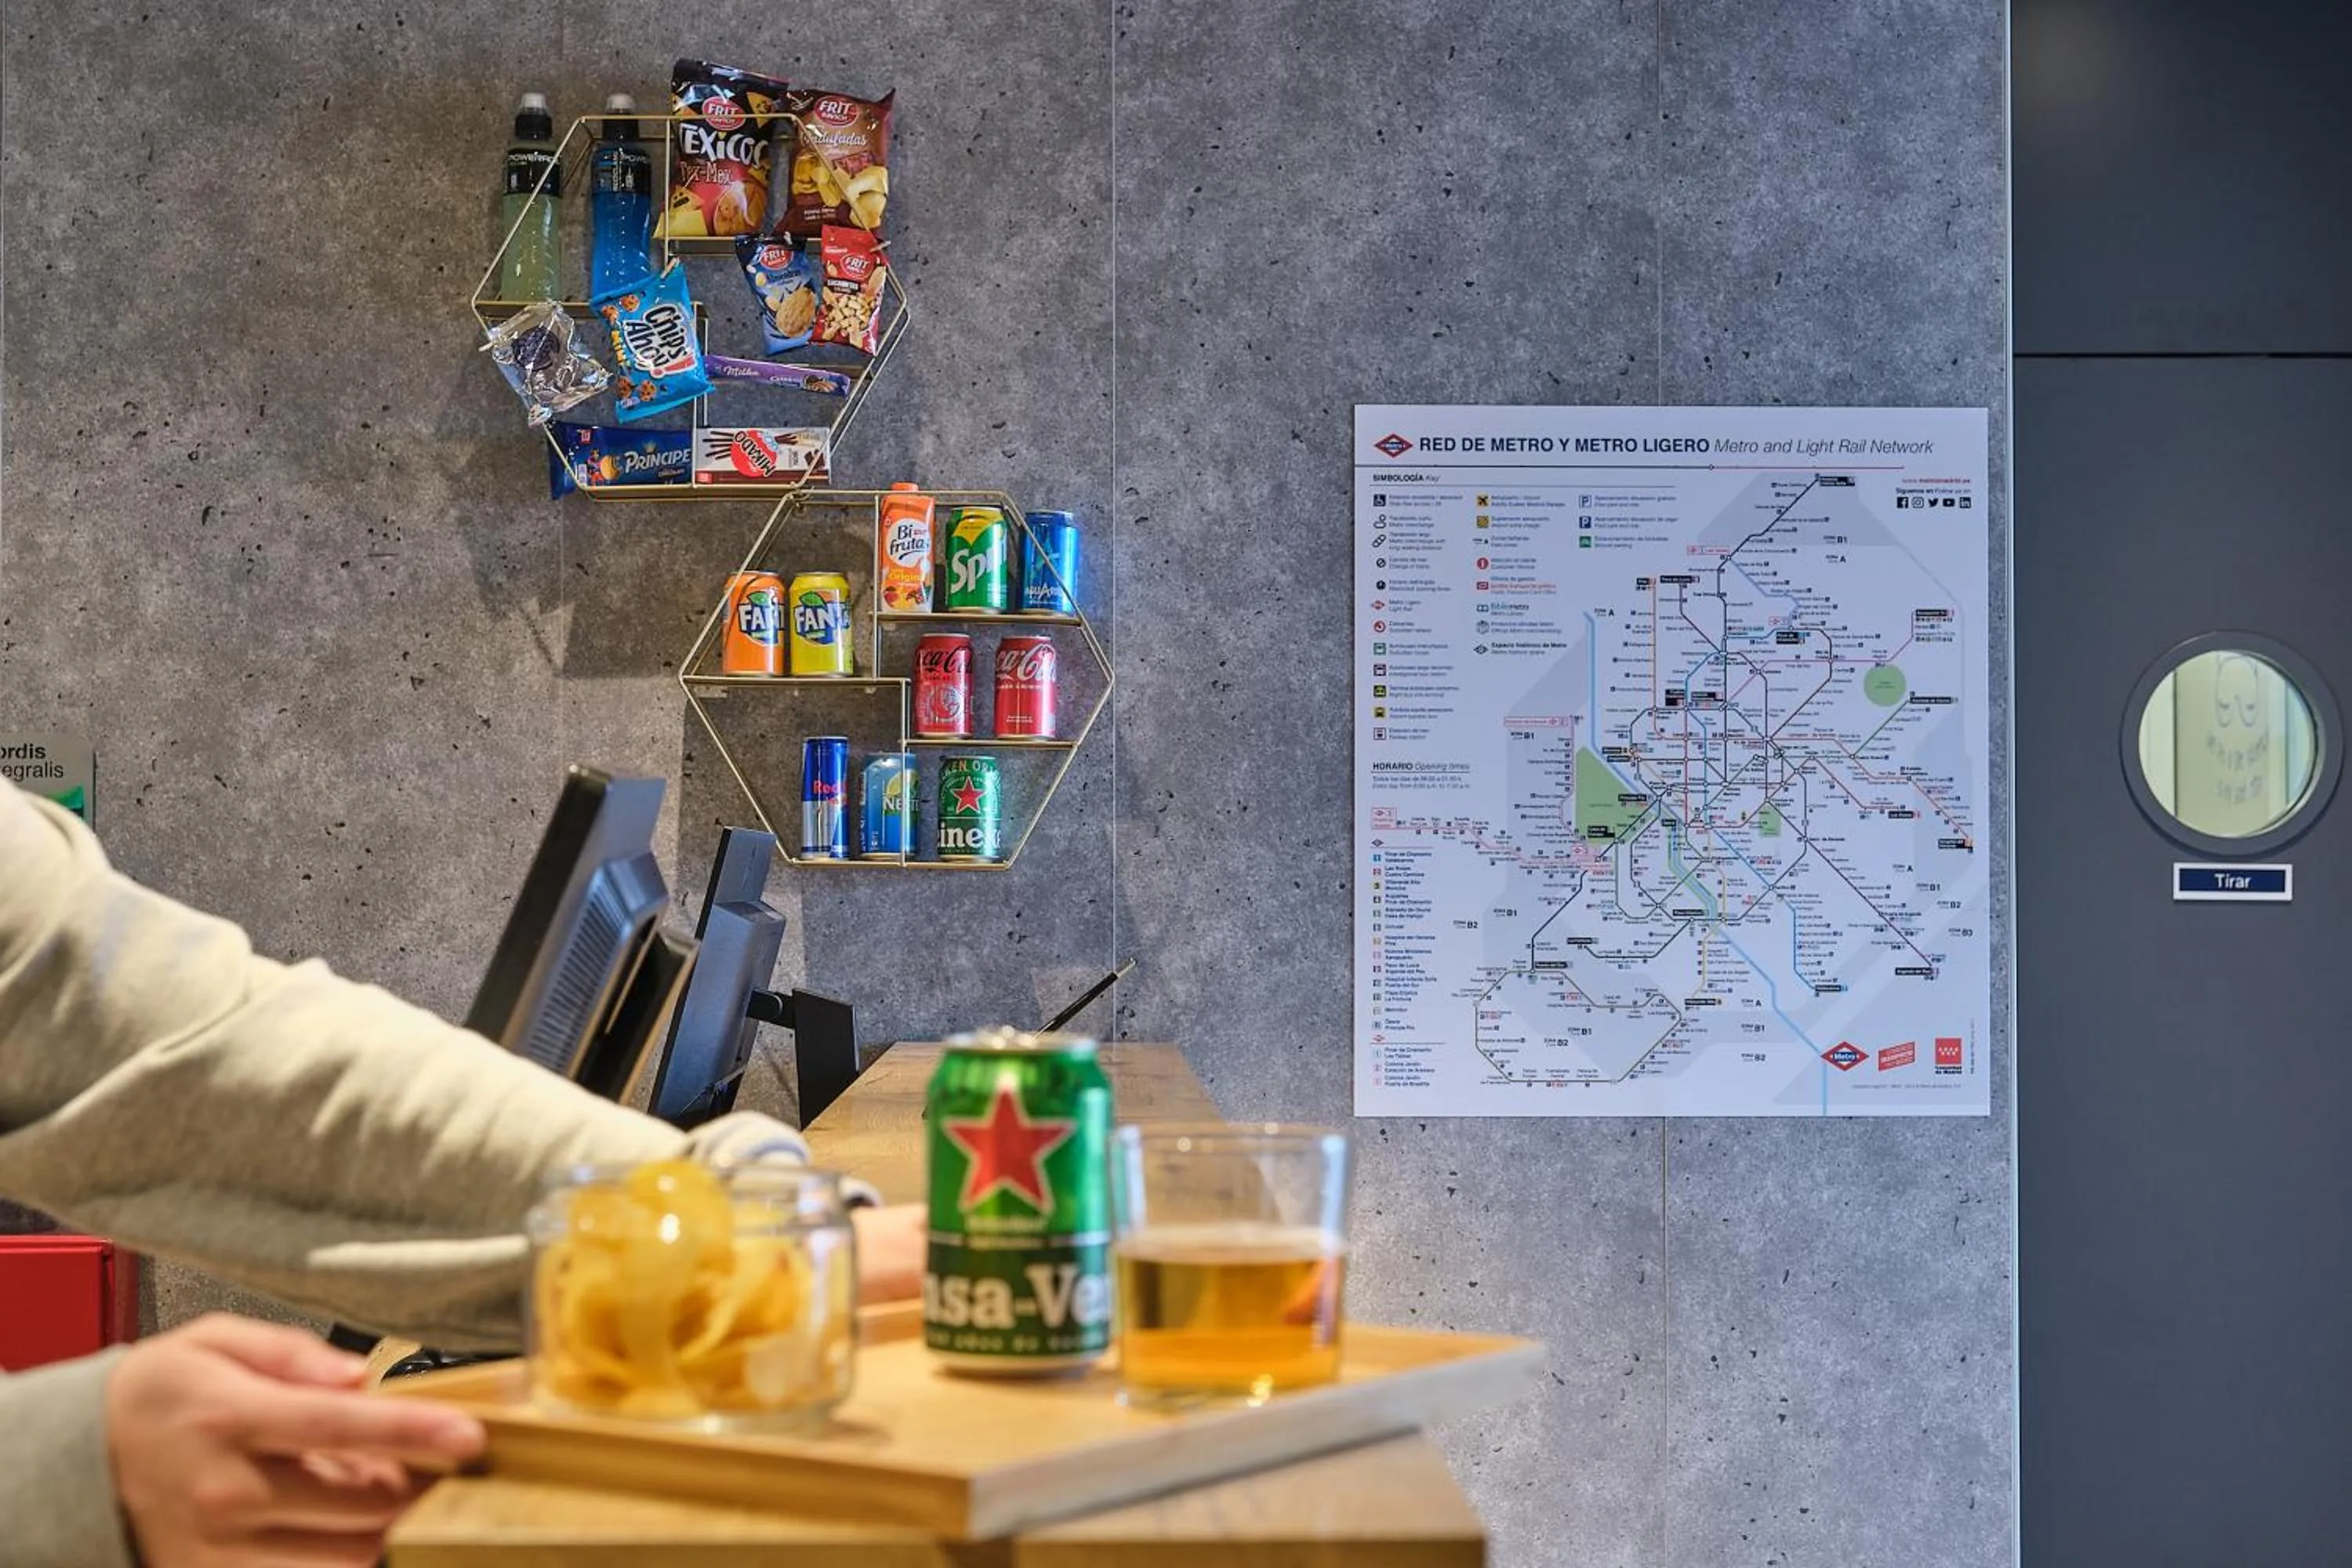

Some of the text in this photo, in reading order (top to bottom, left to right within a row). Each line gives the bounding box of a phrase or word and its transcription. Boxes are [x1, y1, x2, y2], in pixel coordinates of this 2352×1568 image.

[819, 100, 853, 115] FRIT
[844, 256, 869, 270] FRIT
[734, 430, 776, 477] MIKADO
[1420, 437, 1456, 452] RED
[1462, 437, 1485, 452] DE
[1491, 437, 1554, 452] METRO
[1559, 438, 1570, 452] Y
[1575, 438, 1638, 453] METRO
[1643, 439, 1711, 453] LIGERO
[1715, 438, 1759, 453] Metro
[1762, 439, 1791, 453] and
[1797, 438, 1835, 456] Light
[1838, 438, 1867, 453] Rail
[1871, 439, 1934, 454] Network
[898, 524, 913, 540] Bi
[0, 761, 64, 782] egralis
[2214, 873, 2252, 890] Tirar
